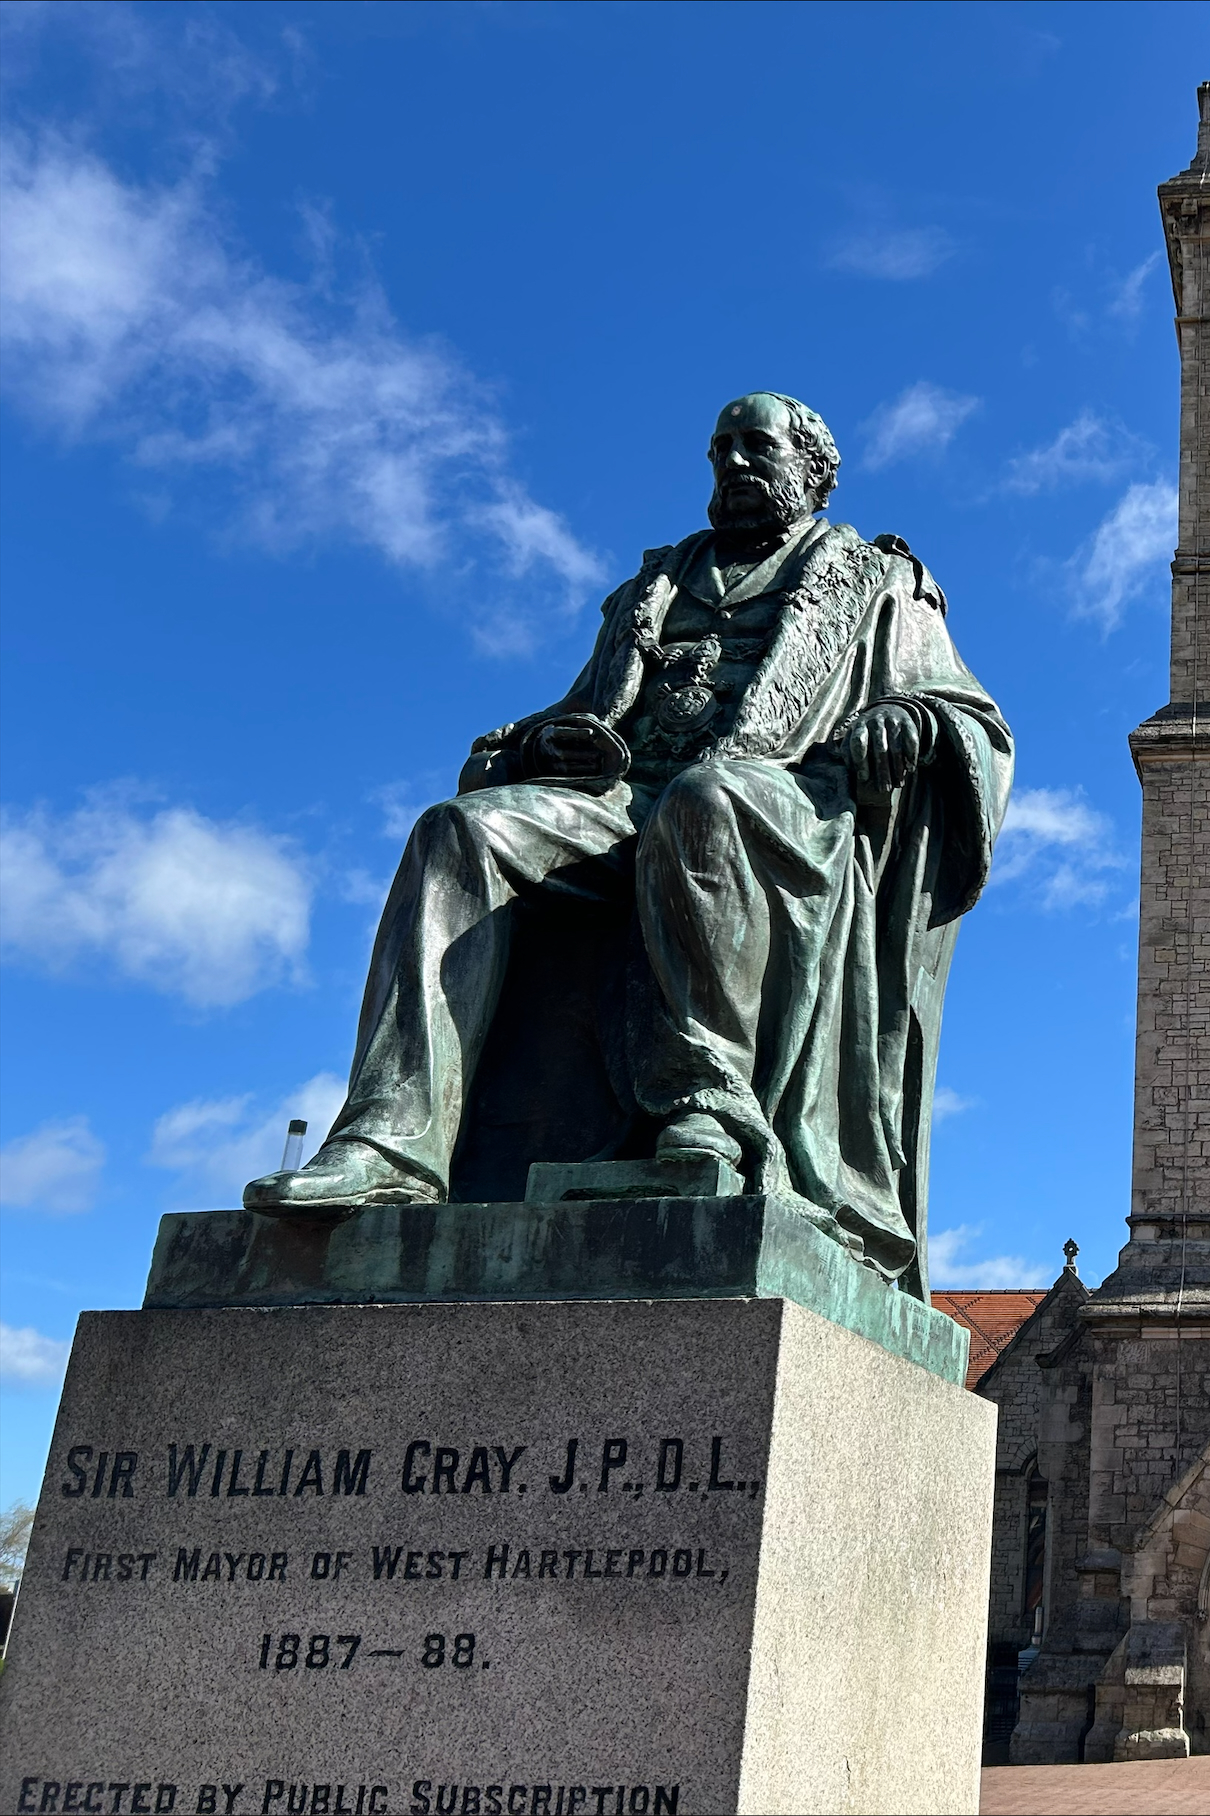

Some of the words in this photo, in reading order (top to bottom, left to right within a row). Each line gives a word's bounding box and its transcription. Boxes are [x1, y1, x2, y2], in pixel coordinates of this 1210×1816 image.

[61, 1444, 138, 1499] SIR
[166, 1443, 372, 1498] WILLIAM
[61, 1548, 156, 1582] FIRST
[172, 1547, 289, 1582] MAYOR
[310, 1551, 352, 1580] OF
[371, 1545, 469, 1581] WEST
[484, 1543, 730, 1584] HARTLEPOOL,
[16, 1776, 179, 1814] ERECTED
[196, 1783, 244, 1814] BY
[261, 1779, 389, 1815] PUBLIC
[410, 1780, 681, 1815] SUBSCRIPTION
